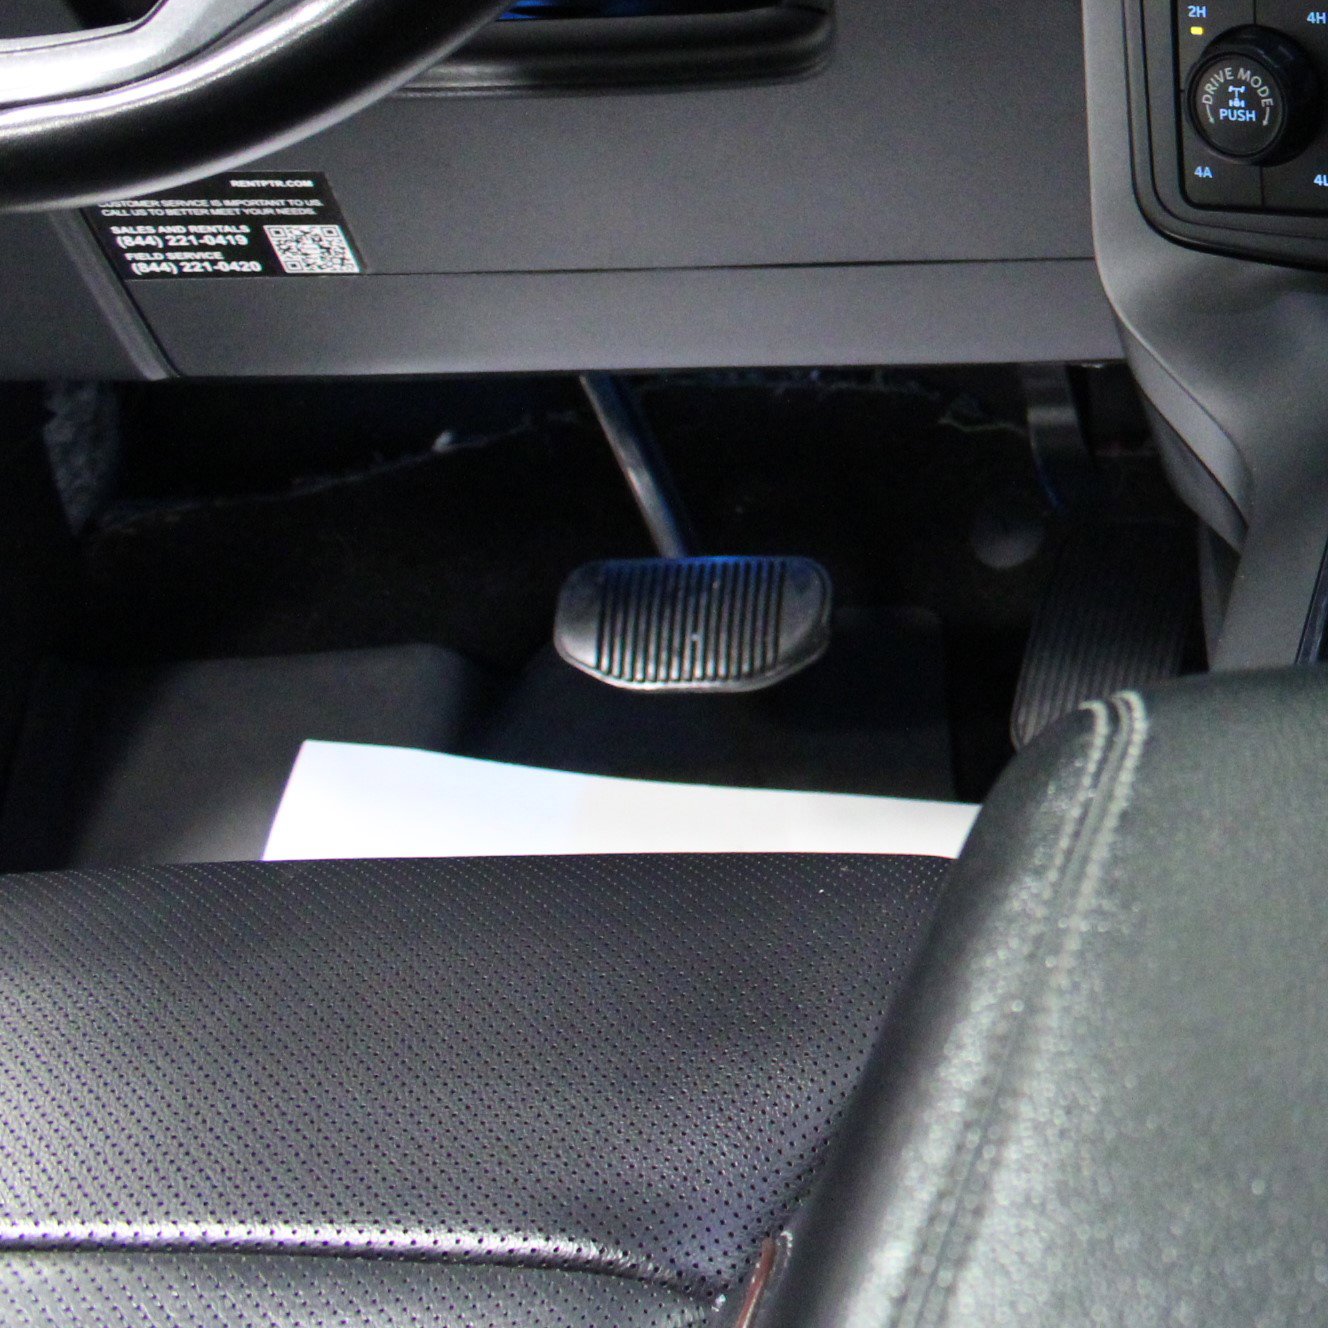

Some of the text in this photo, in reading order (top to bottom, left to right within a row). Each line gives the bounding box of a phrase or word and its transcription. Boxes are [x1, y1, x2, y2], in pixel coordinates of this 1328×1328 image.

[1188, 6, 1206, 18] 2H
[1307, 12, 1326, 24] 4H
[1202, 67, 1274, 107] DRIVE MODE
[1219, 109, 1256, 121] PUSH
[1193, 166, 1213, 179] 4A
[160, 199, 209, 207] SERVICE
[187, 225, 250, 233] RENTALS
[115, 235, 249, 249] (844) 221-0419
[165, 252, 224, 260] SERVICE
[131, 262, 262, 275] (844) 221-0420
